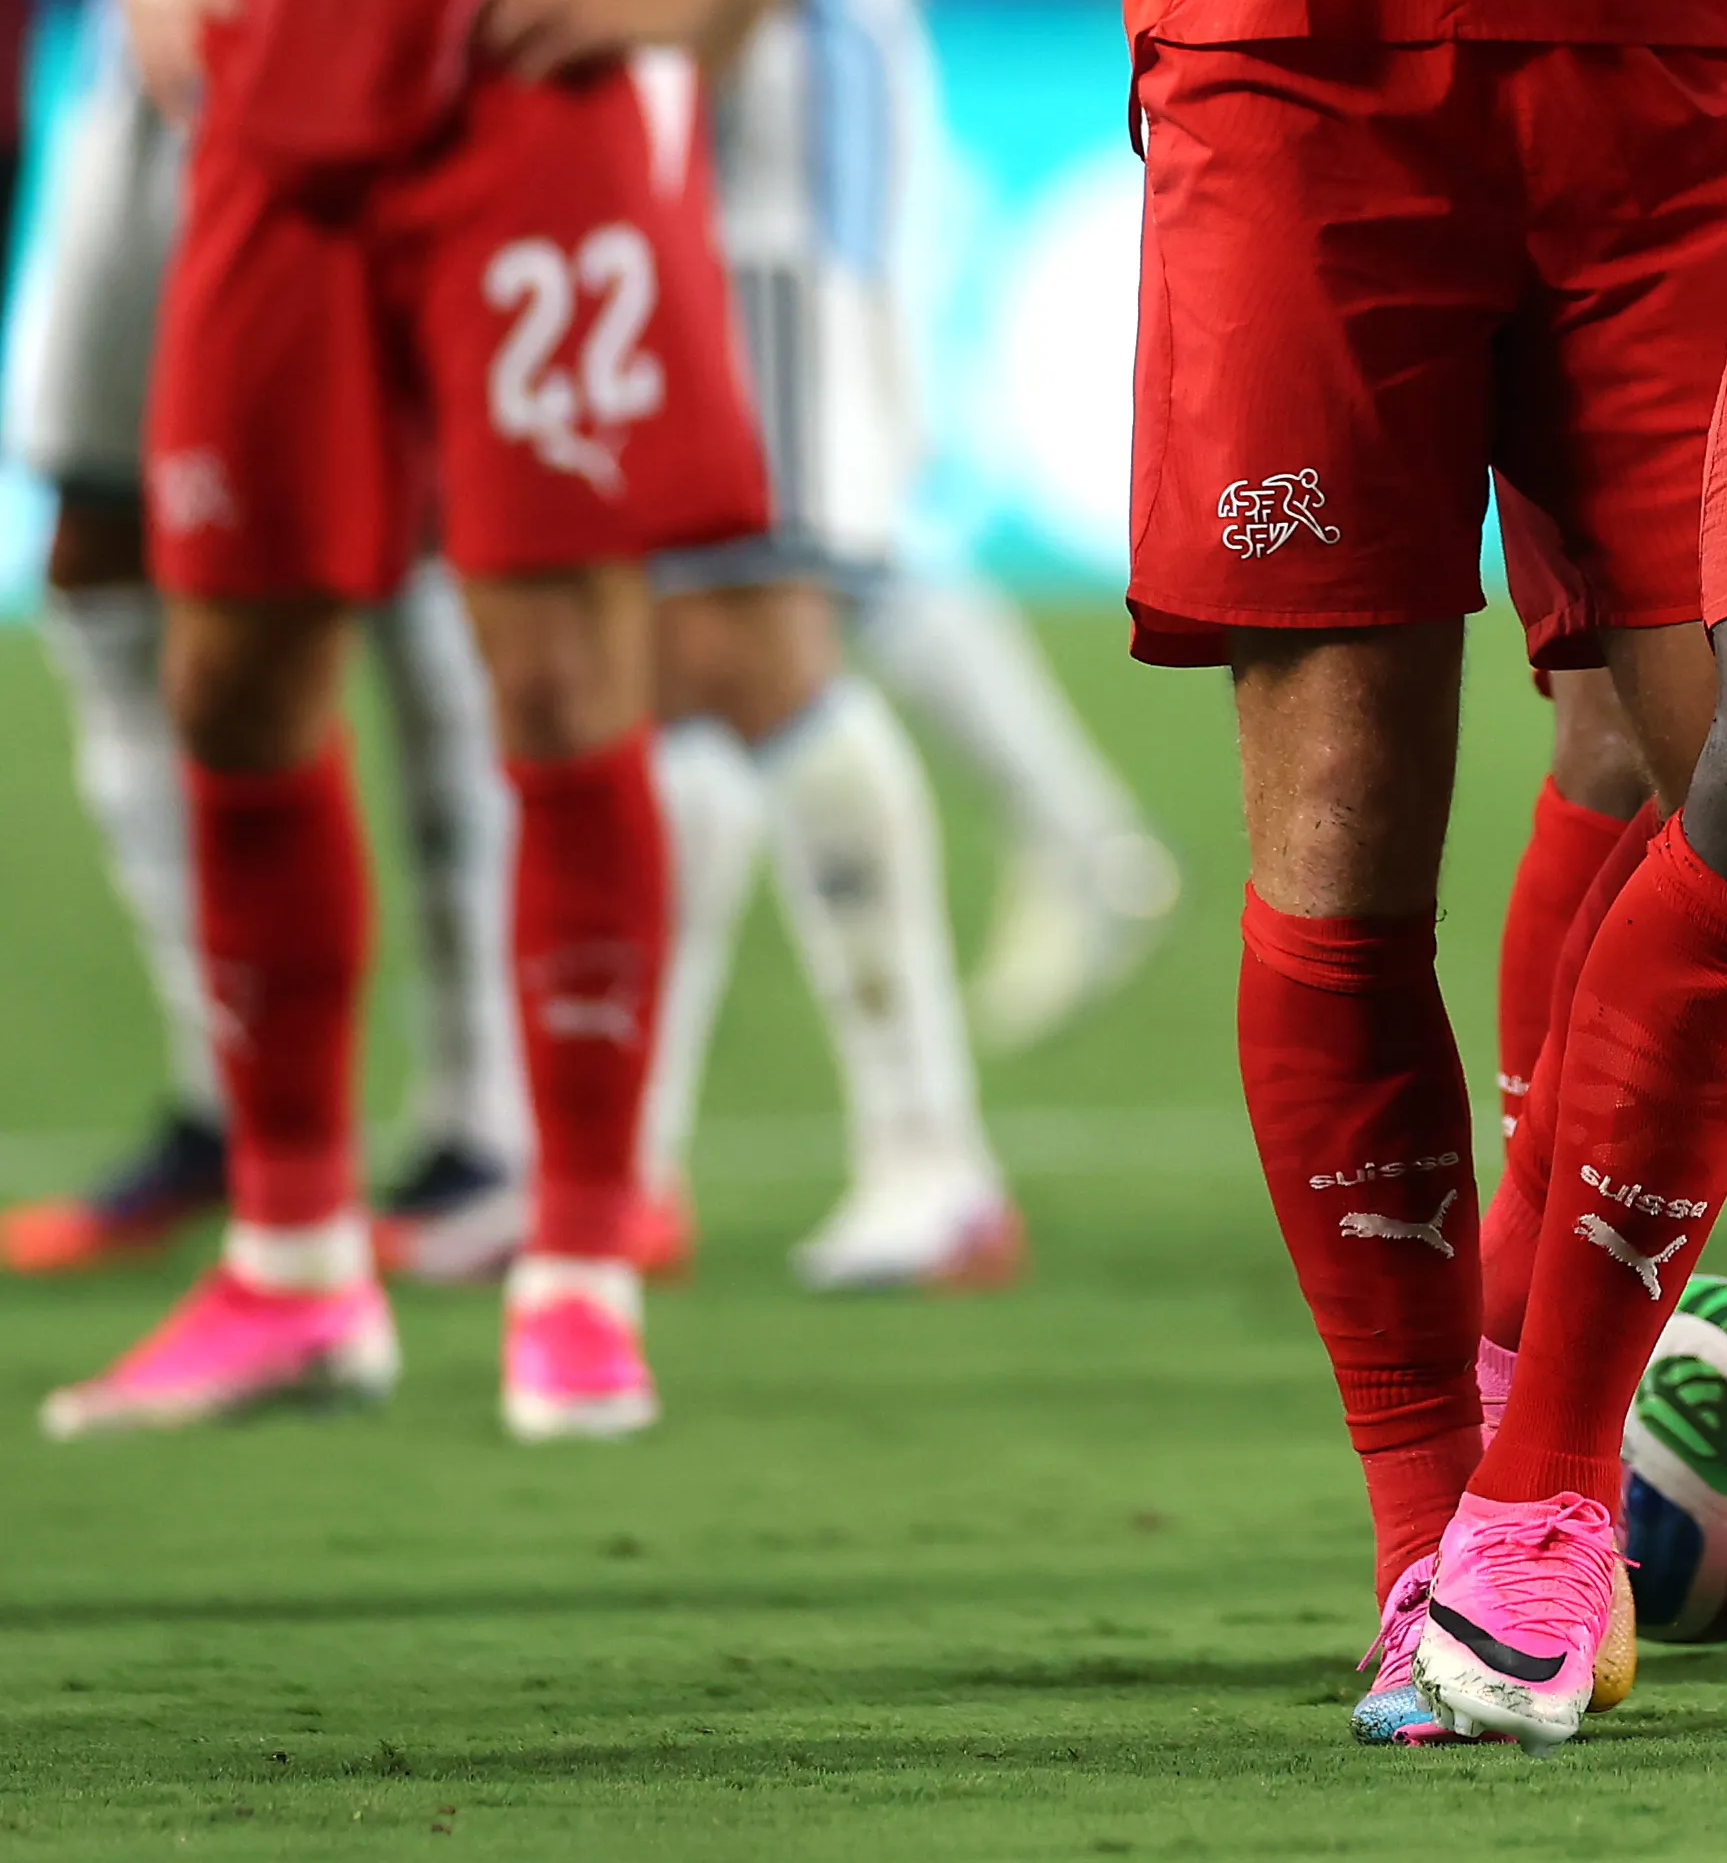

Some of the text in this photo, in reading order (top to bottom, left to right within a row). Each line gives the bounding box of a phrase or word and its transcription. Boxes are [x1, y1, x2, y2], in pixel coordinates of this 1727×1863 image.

[483, 221, 665, 444] 22
[1308, 1151, 1459, 1190] suisse
[1580, 1164, 1708, 1219] suisse
